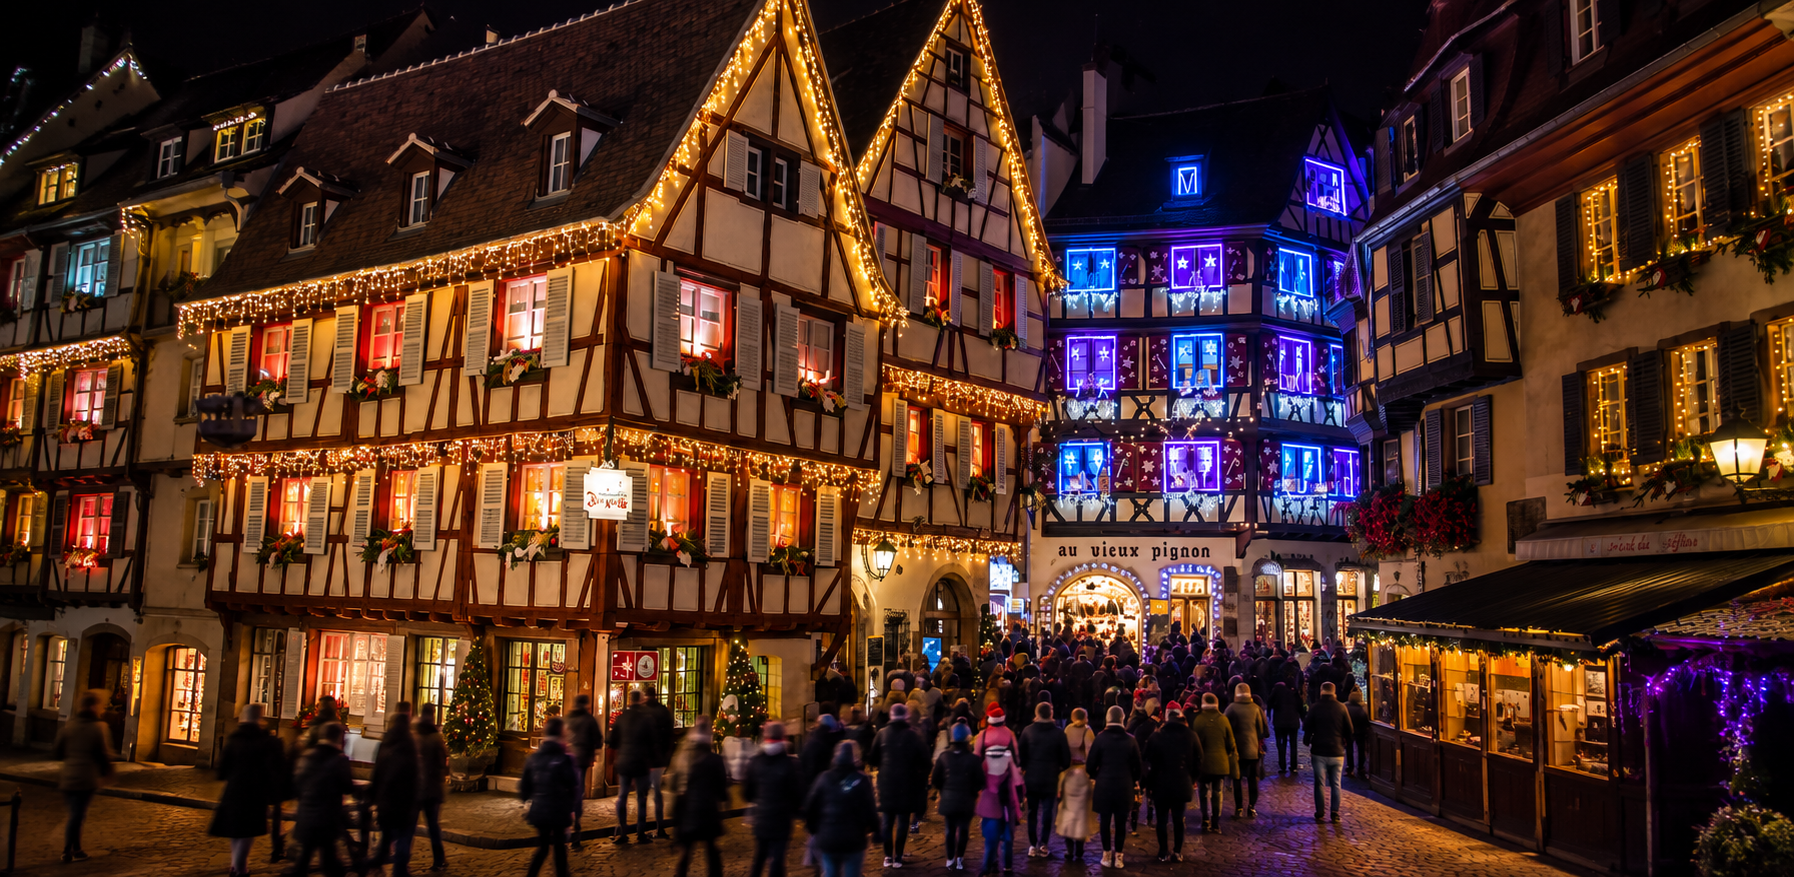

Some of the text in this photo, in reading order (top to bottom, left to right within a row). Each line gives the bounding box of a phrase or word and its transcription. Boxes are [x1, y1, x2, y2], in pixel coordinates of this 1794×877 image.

[1058, 541, 1211, 561] au vieux pignon
